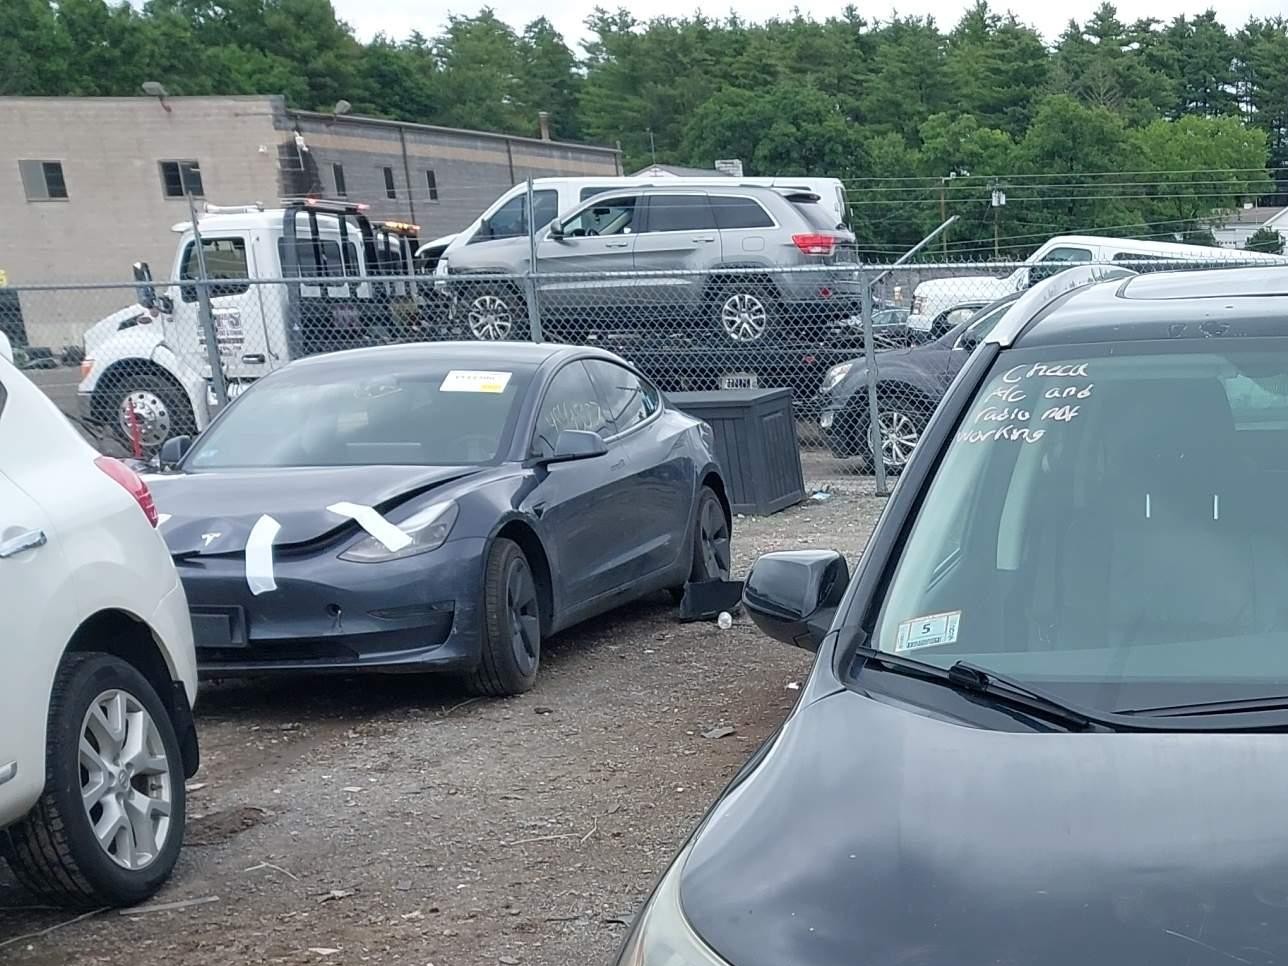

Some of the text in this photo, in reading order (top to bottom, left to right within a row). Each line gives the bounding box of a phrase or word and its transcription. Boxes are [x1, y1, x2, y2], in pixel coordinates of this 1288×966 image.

[1045, 384, 1094, 398] and
[974, 406, 1030, 423] radio
[921, 623, 931, 634] 5
